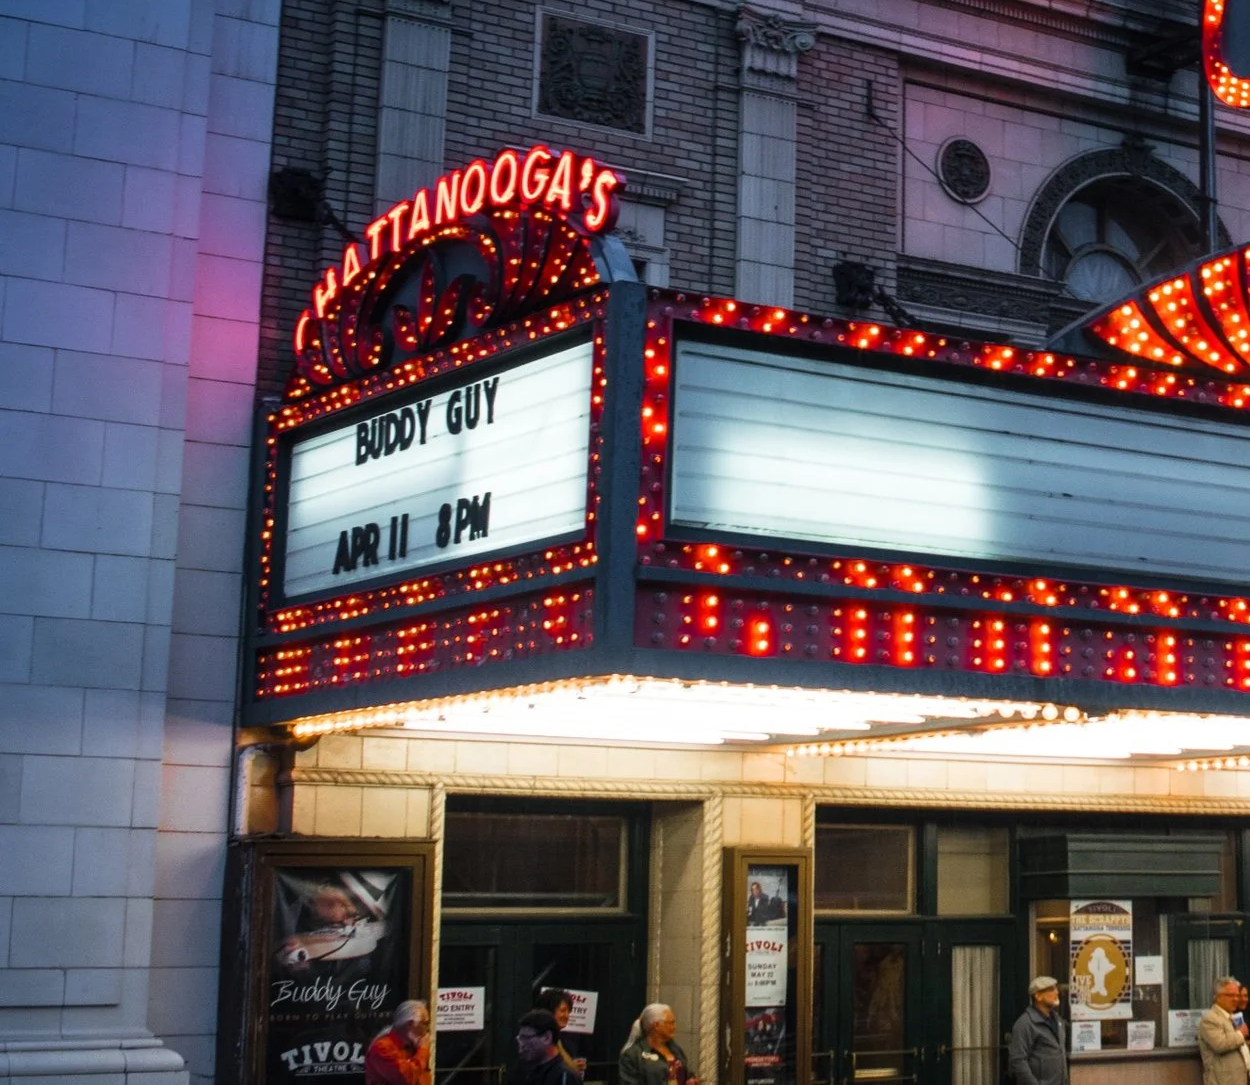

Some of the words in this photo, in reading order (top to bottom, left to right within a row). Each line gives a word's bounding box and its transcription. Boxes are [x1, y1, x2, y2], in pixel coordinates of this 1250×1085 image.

[293, 145, 622, 355] CHATTANOOGA'S
[356, 399, 433, 466] BUDDY
[446, 376, 500, 435] GUY
[332, 522, 380, 575] APR
[270, 976, 347, 1011] Buddy
[347, 978, 392, 1010] Guy
[437, 1005, 449, 1013] NO
[451, 1004, 475, 1012] ENTRY
[280, 1041, 366, 1072] TIVOL
